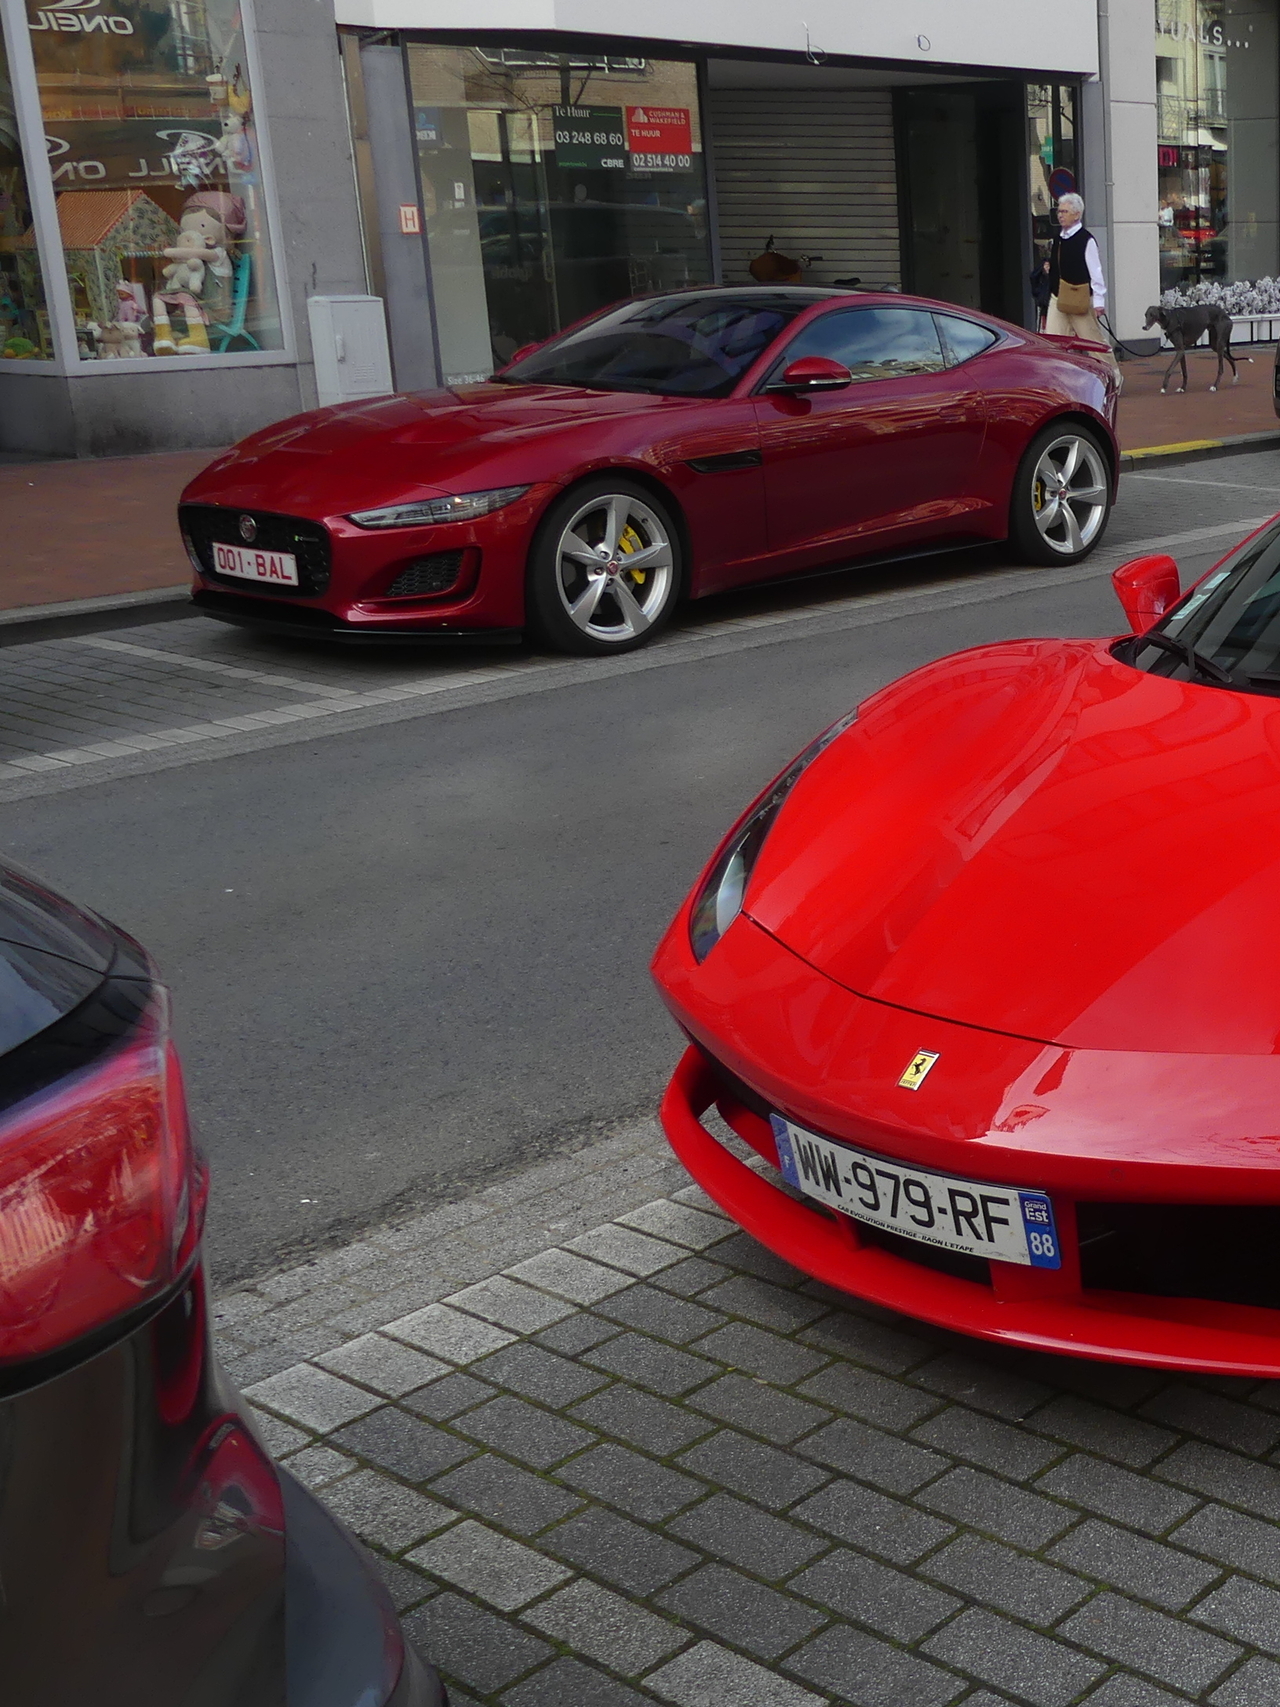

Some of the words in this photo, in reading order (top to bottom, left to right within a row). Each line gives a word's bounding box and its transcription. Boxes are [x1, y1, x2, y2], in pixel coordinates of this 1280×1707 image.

[553, 106, 566, 117] Te
[567, 106, 591, 118] Huur
[648, 110, 680, 118] CUSHMAN
[648, 117, 686, 125] WAKEFIELD
[556, 131, 570, 143] 03
[572, 131, 592, 144] 248
[593, 132, 607, 145] 68
[609, 133, 623, 145] 60
[601, 159, 624, 168] CBRE
[633, 154, 645, 166] 02
[647, 154, 661, 166] 514
[664, 155, 676, 167] 40
[678, 155, 691, 167] 00
[403, 210, 417, 229] H
[794, 1133, 1011, 1243] WW-979-RF
[1024, 1200, 1047, 1210] Grand
[1025, 1207, 1049, 1222] Est
[837, 1204, 849, 1213] CAR
[850, 1210, 886, 1228] EVOLUTION
[886, 1224, 917, 1238] PRESTIGE
[921, 1235, 944, 1246] RAON
[944, 1240, 974, 1253] L'ETAPE
[1030, 1232, 1055, 1257] 88
